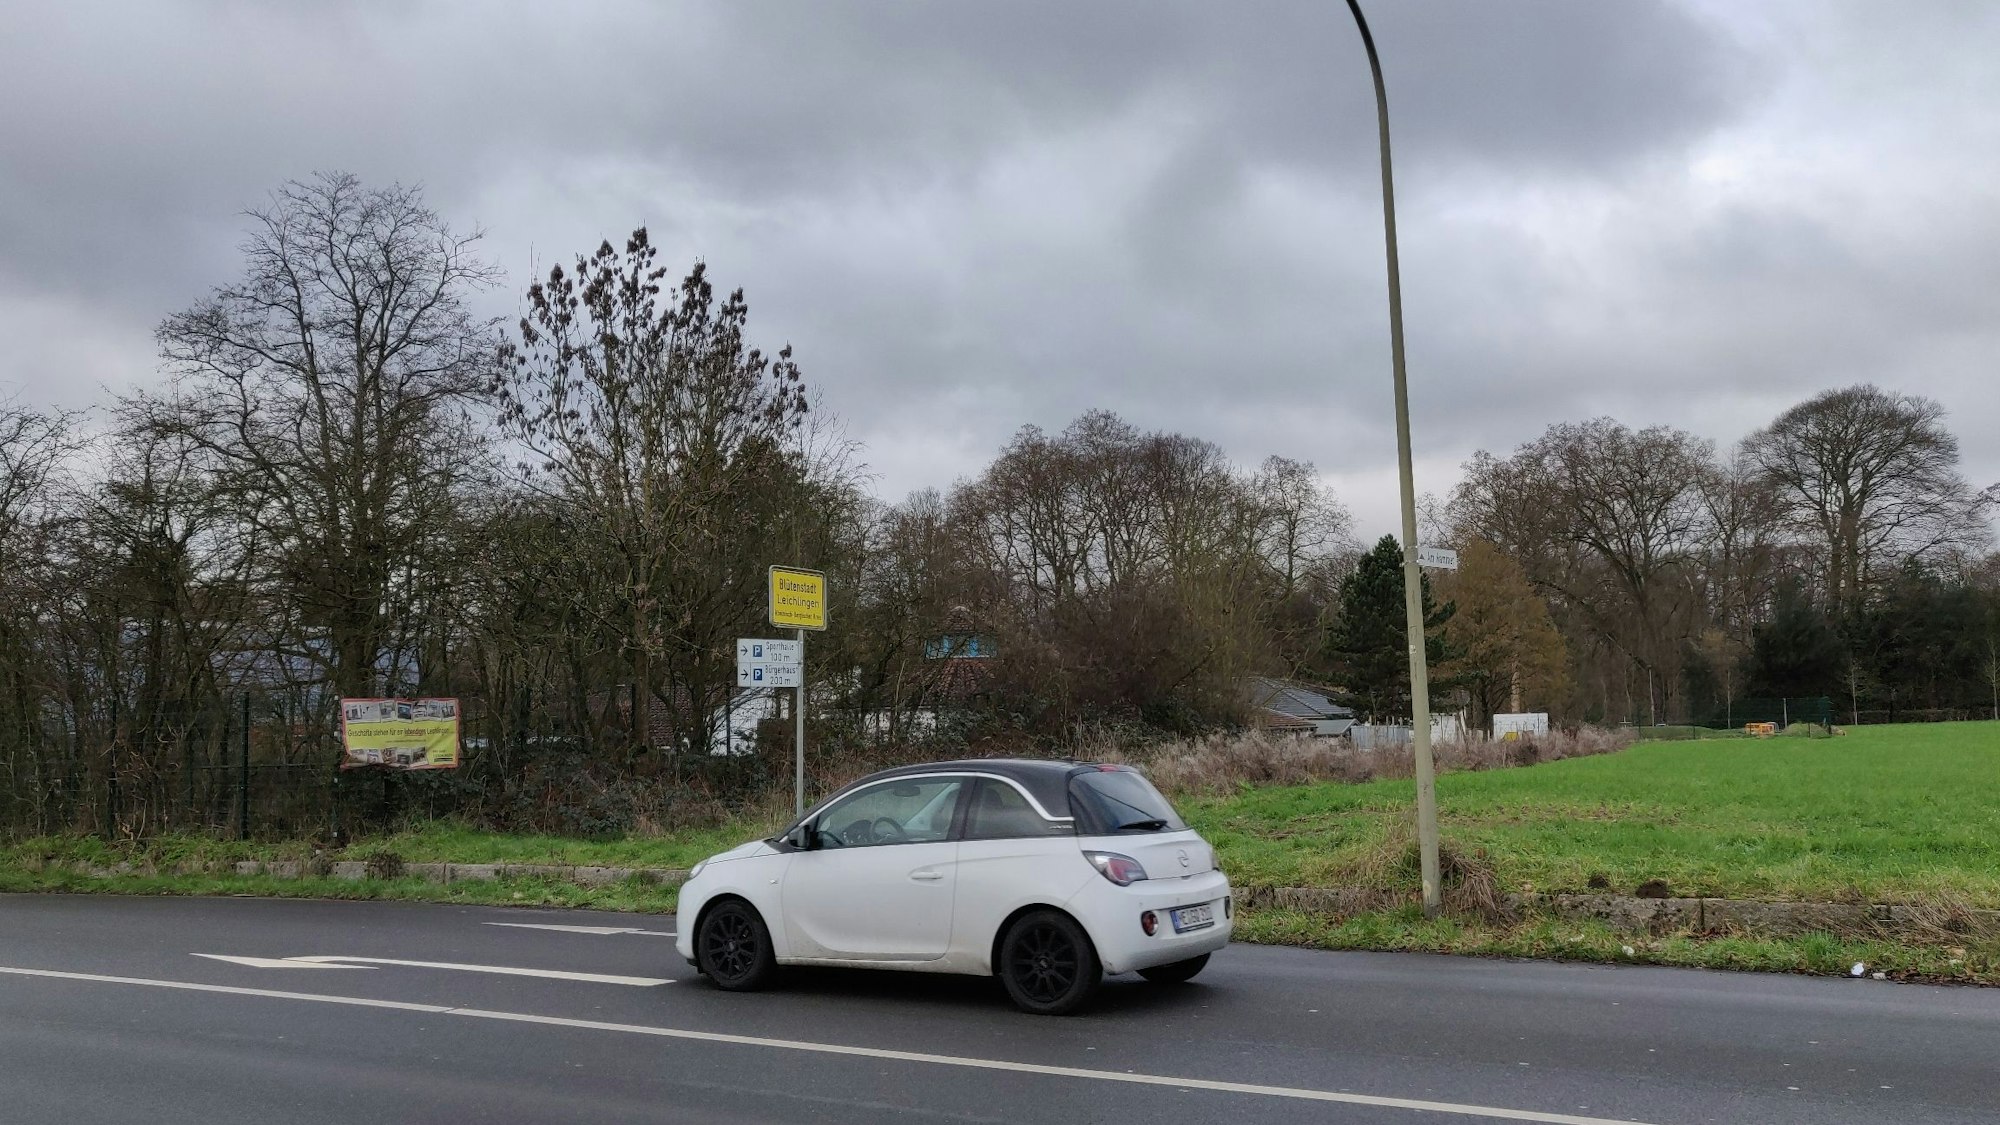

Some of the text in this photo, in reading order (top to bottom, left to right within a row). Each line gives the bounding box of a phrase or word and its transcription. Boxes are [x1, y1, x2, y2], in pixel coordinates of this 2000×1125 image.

[779, 578, 817, 594] Blütenstadt
[777, 594, 820, 609] Leichlingen
[766, 642, 794, 652] Sporthalle
[770, 653, 790, 662] 100 m
[765, 665, 796, 676] Bürgerhaus
[770, 676, 791, 685] 200 m
